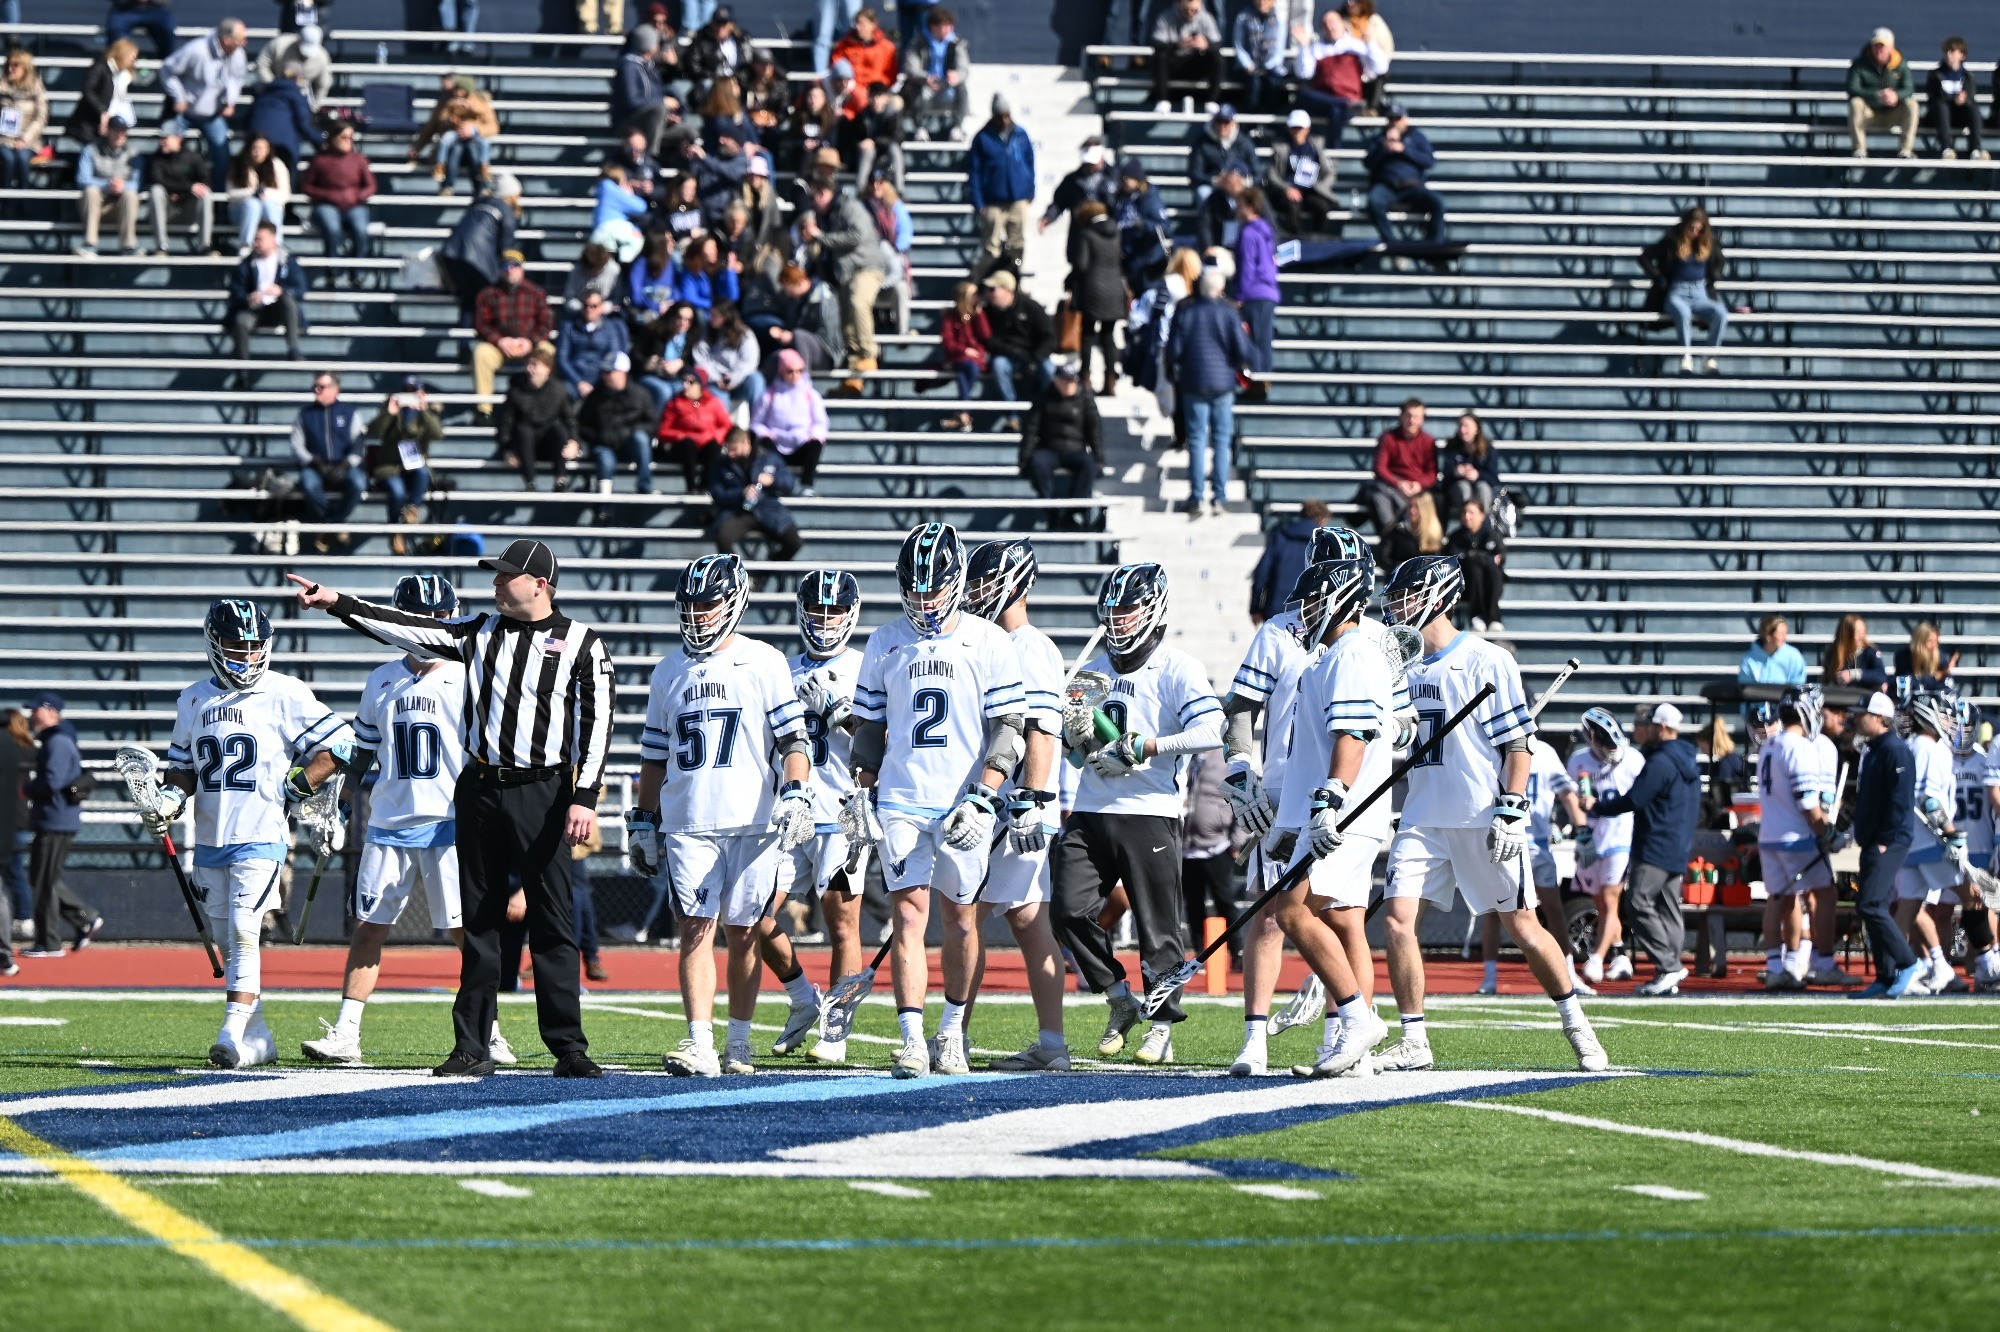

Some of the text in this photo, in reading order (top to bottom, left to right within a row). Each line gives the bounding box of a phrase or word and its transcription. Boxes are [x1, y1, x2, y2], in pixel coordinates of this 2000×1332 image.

[909, 660, 954, 680] VILLANOVA
[684, 682, 726, 705] VILLANOVA
[1409, 683, 1441, 701] ILLANOVA
[202, 706, 244, 728] VILLANOVA
[395, 696, 436, 715] VILLANOVA
[912, 687, 948, 748] 2
[393, 722, 440, 779] 10
[676, 707, 743, 772] 57
[196, 732, 257, 792] 22
